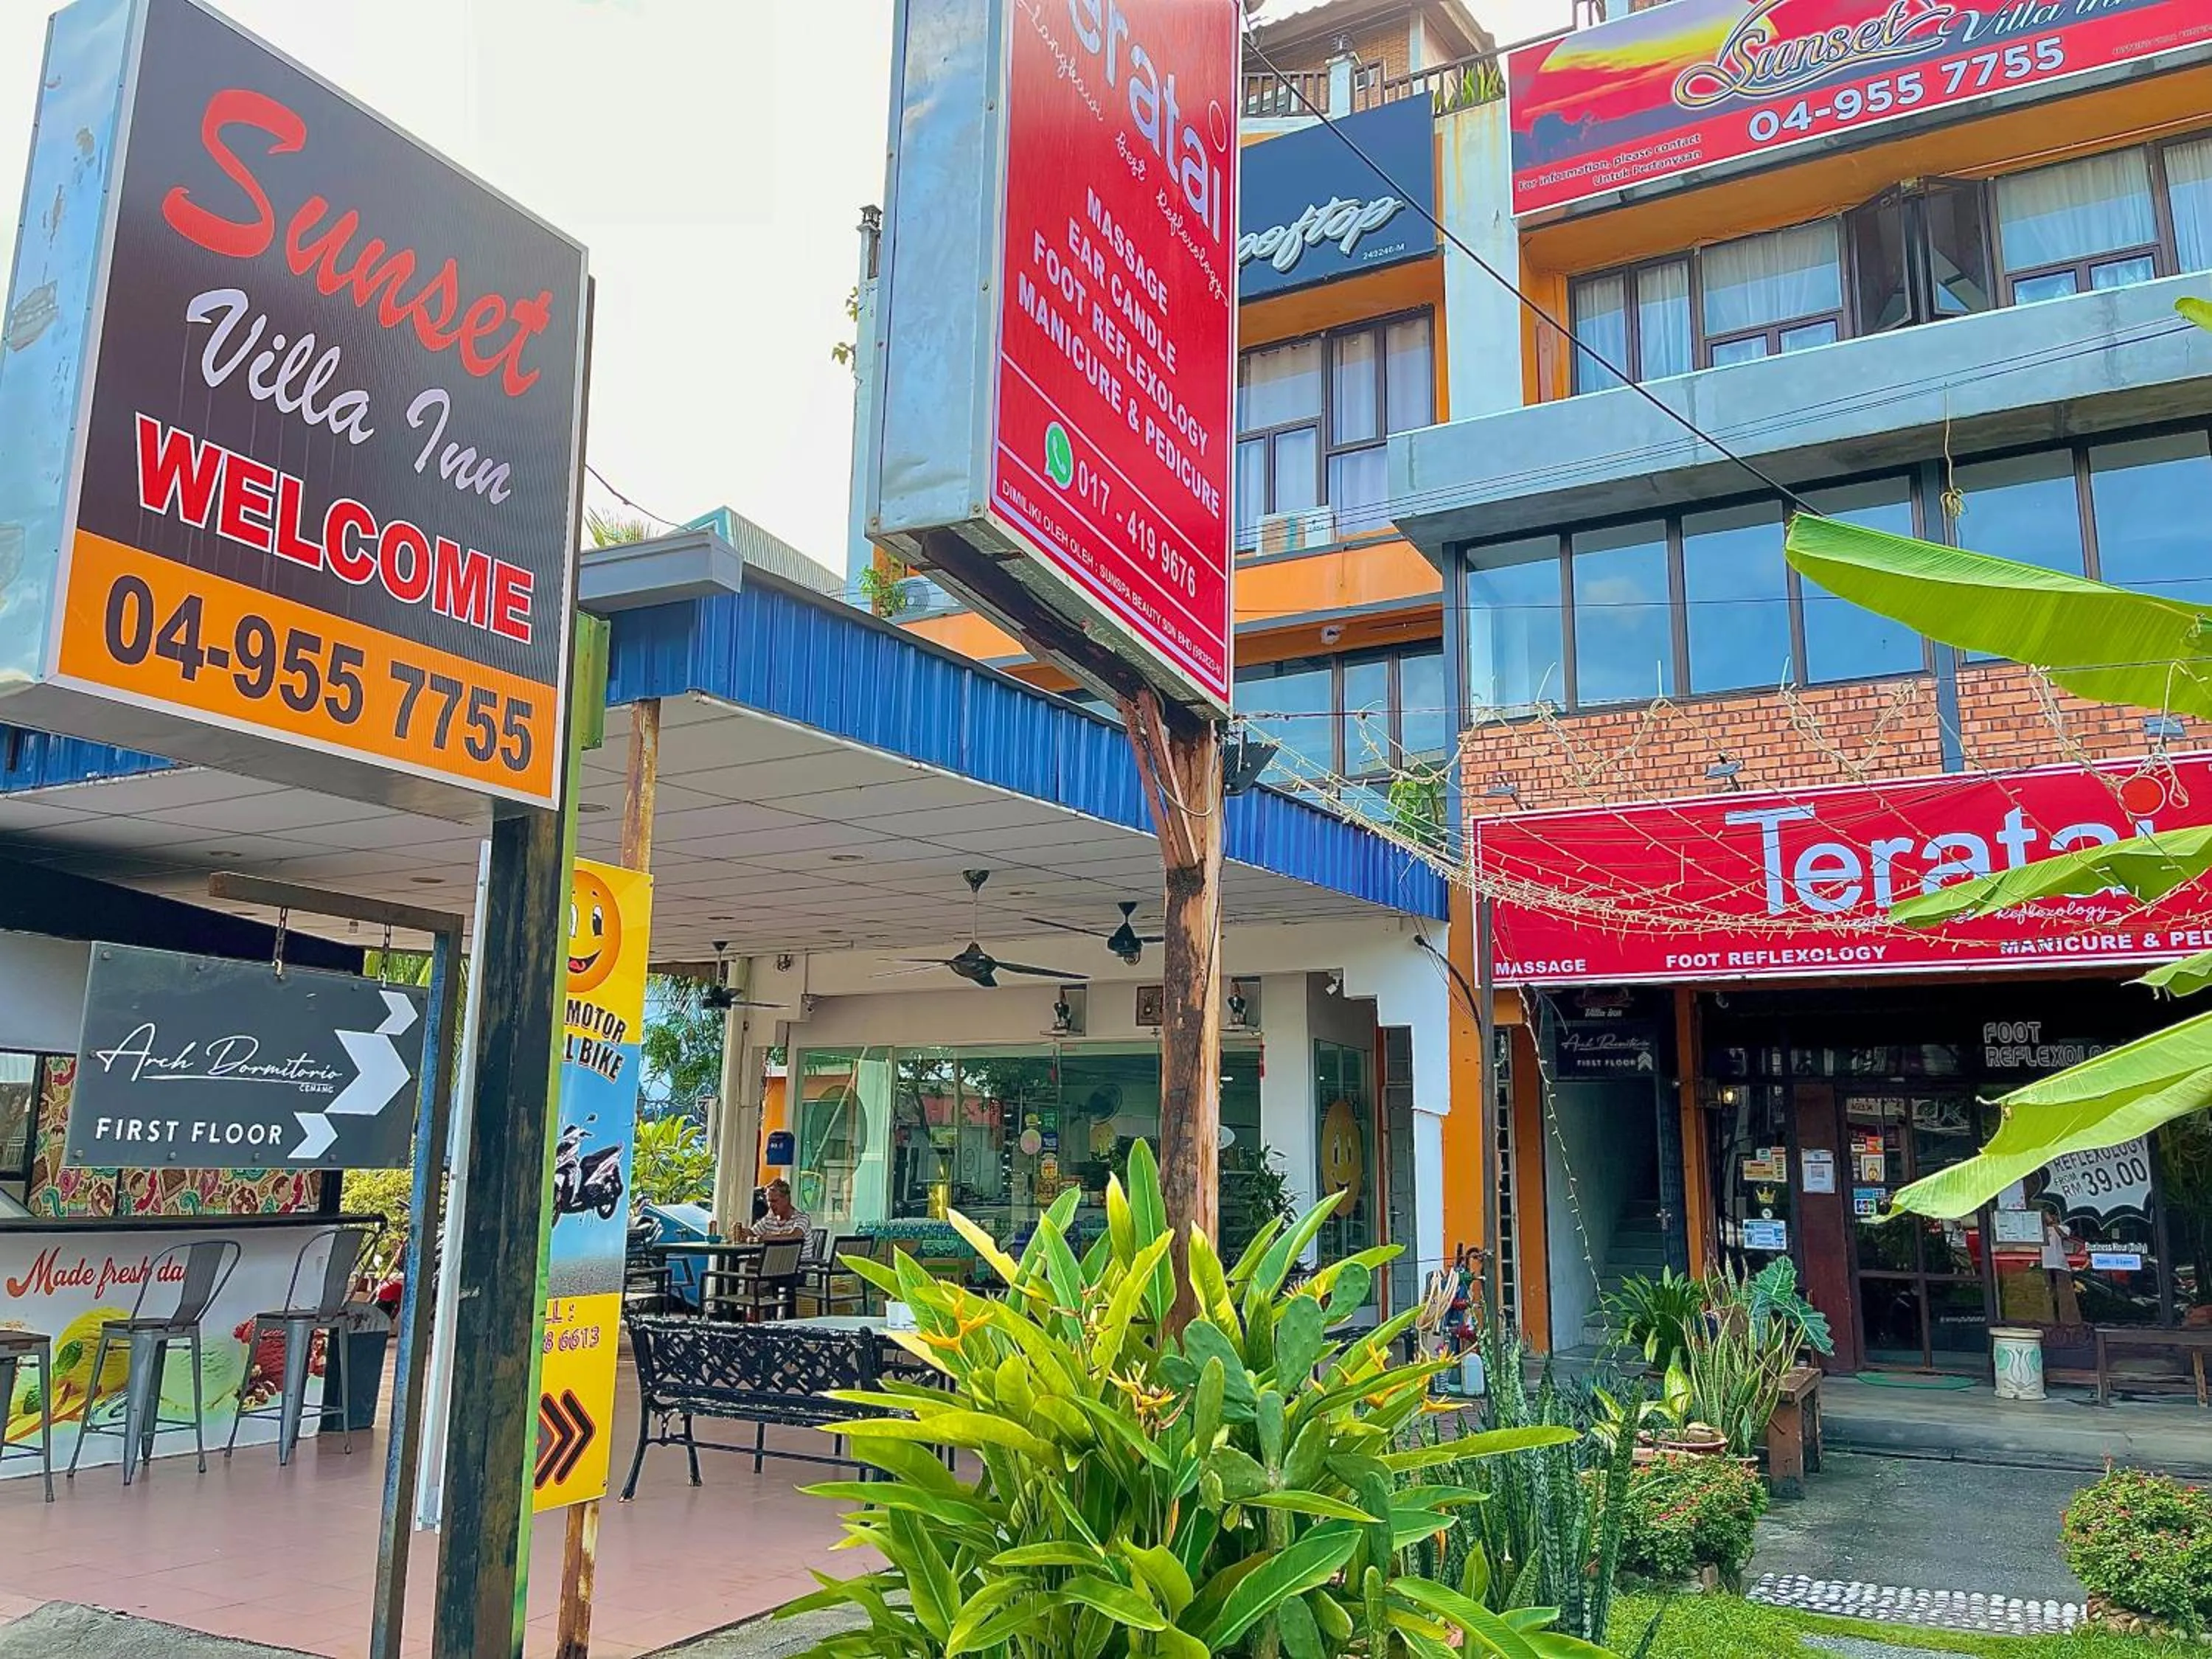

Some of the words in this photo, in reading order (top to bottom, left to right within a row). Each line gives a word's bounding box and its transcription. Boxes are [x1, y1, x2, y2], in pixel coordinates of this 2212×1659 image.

[1677, 0, 1921, 103] Sunset
[1938, 0, 2065, 43] Villa
[1747, 71, 1924, 142] 04-955
[1941, 37, 2065, 95] 7755
[1068, 0, 1221, 245] eratai
[1613, 147, 1653, 167] please
[1655, 133, 1700, 154] contact
[1593, 169, 1629, 186] Untuk
[162, 88, 553, 397] Sunset
[1088, 185, 1168, 317] MASSAGE
[1239, 196, 1405, 273] ooftop
[1068, 217, 1105, 290] EAR
[1111, 274, 1177, 375] CANDLE
[1034, 229, 1087, 316] FOOT
[1093, 301, 1208, 457] REFLEXOLOGY
[187, 288, 375, 441] Villa
[407, 389, 512, 505] Inn
[1018, 271, 1122, 414] MANICURE
[1127, 397, 1140, 434] &
[1145, 414, 1220, 520] PEDICURE
[136, 412, 535, 645] WELCOME
[1002, 479, 1042, 524] DIMILIKI
[1043, 517, 1069, 548] OLEH
[1070, 539, 1094, 569] OLEH
[1099, 563, 1132, 601] SUNSPA
[1132, 591, 1162, 625] BEAUTY
[1078, 459, 1110, 517] 017
[1127, 510, 1156, 561] 419
[1161, 540, 1196, 599] 9676
[105, 574, 366, 726] 04-955
[390, 660, 534, 772] 7755
[1725, 804, 2154, 916] Terat
[1495, 959, 1587, 975] MASSAGE
[1666, 953, 1719, 969] FOOT
[1728, 945, 1887, 967] REFLEXOLOGY
[2000, 933, 2133, 955] MANICURE
[2143, 932, 2161, 948] &
[96, 1022, 195, 1082] Arch
[206, 1034, 344, 1078] Dormitorio
[563, 998, 627, 1046] MOTOR
[577, 1036, 625, 1082] BIKE
[1576, 1059, 1601, 1068] FIRST
[1604, 1059, 1636, 1067] FLOOR
[1983, 1021, 2042, 1044] FOOT
[95, 1117, 180, 1143] FIRST
[191, 1121, 283, 1146] FLOOR
[2053, 1172, 2078, 1186] FROM
[2062, 1182, 2084, 1199] RM
[2081, 1157, 2148, 1197] 39.00
[7, 1246, 97, 1298] Made
[94, 1255, 153, 1300] fresh
[157, 1254, 187, 1283] da
[558, 1325, 600, 1352] 6613
